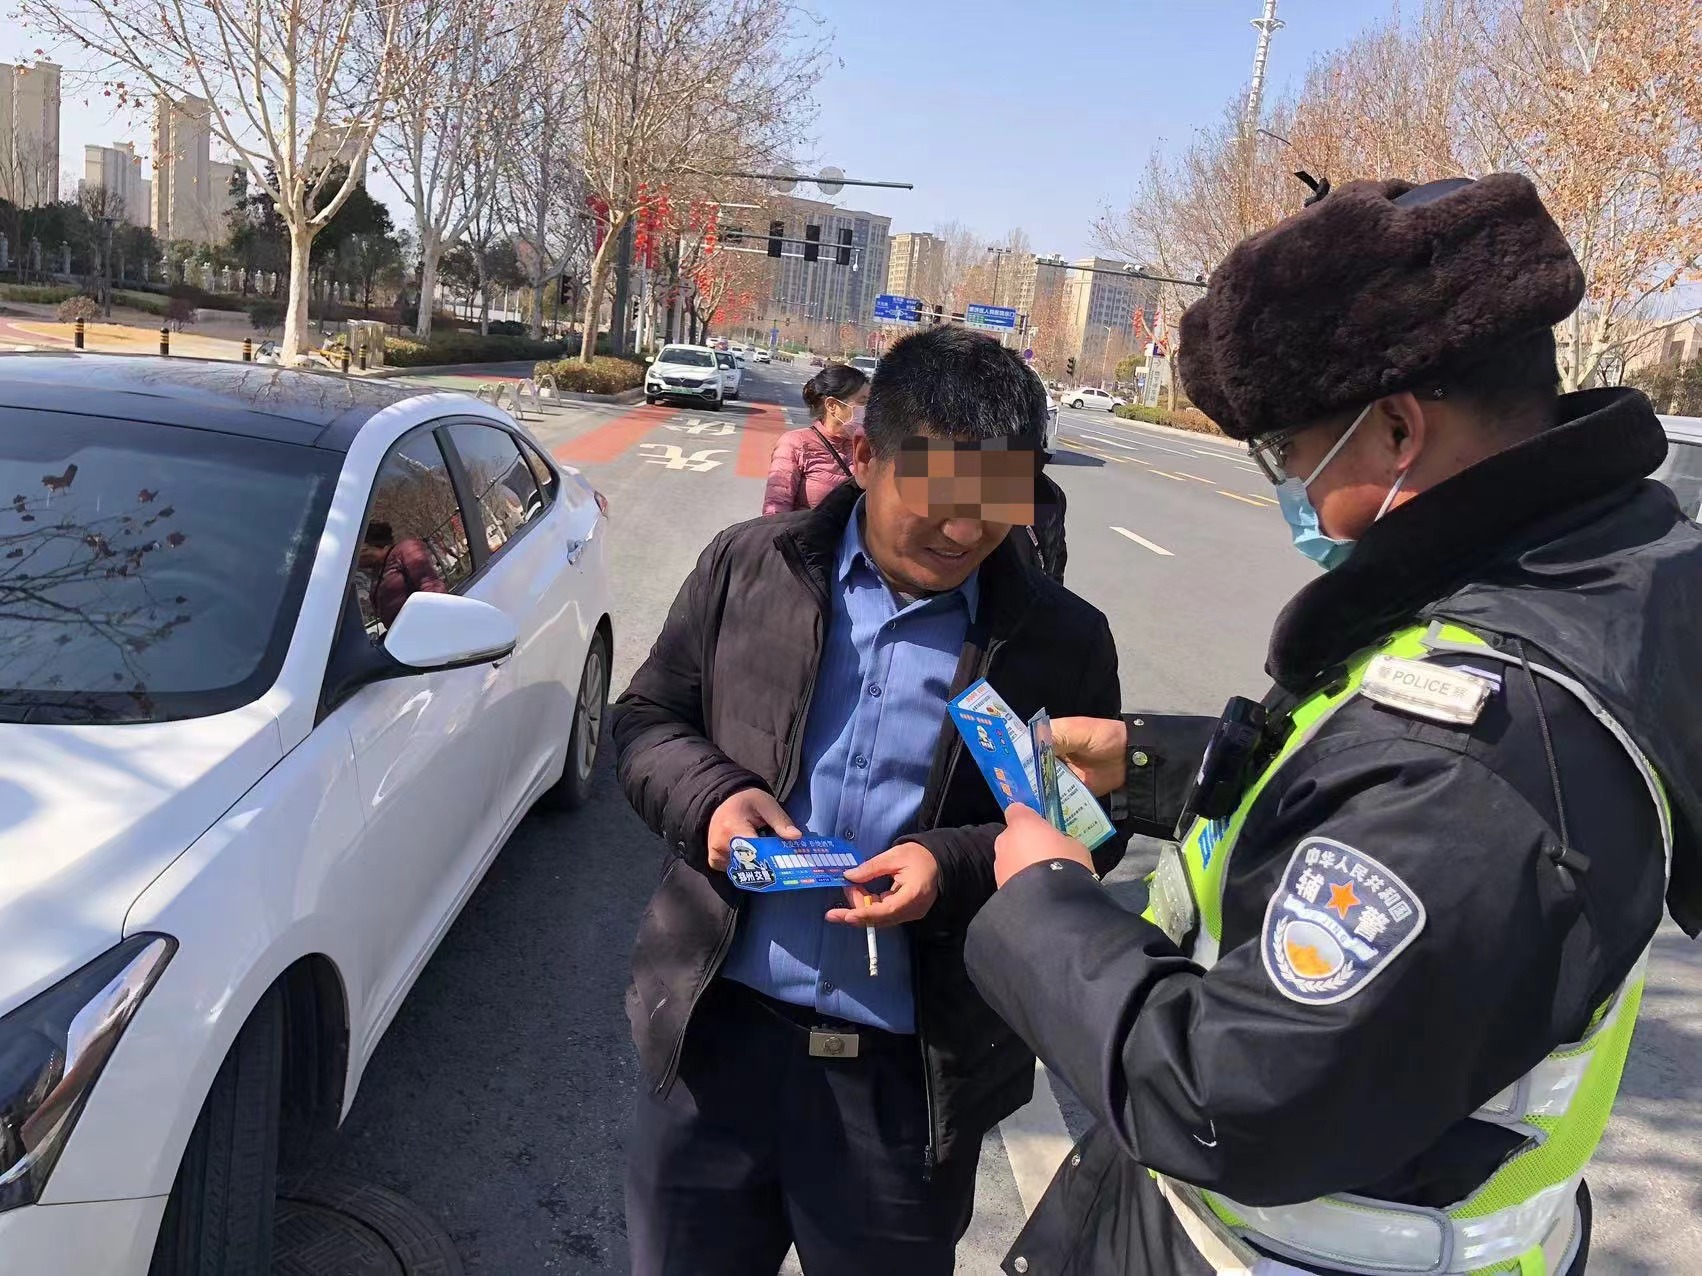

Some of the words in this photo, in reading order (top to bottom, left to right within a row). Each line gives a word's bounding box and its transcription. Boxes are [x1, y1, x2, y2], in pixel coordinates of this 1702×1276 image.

[1393, 670, 1452, 696] POLICE
[1304, 848, 1413, 922] 中华人民共和国
